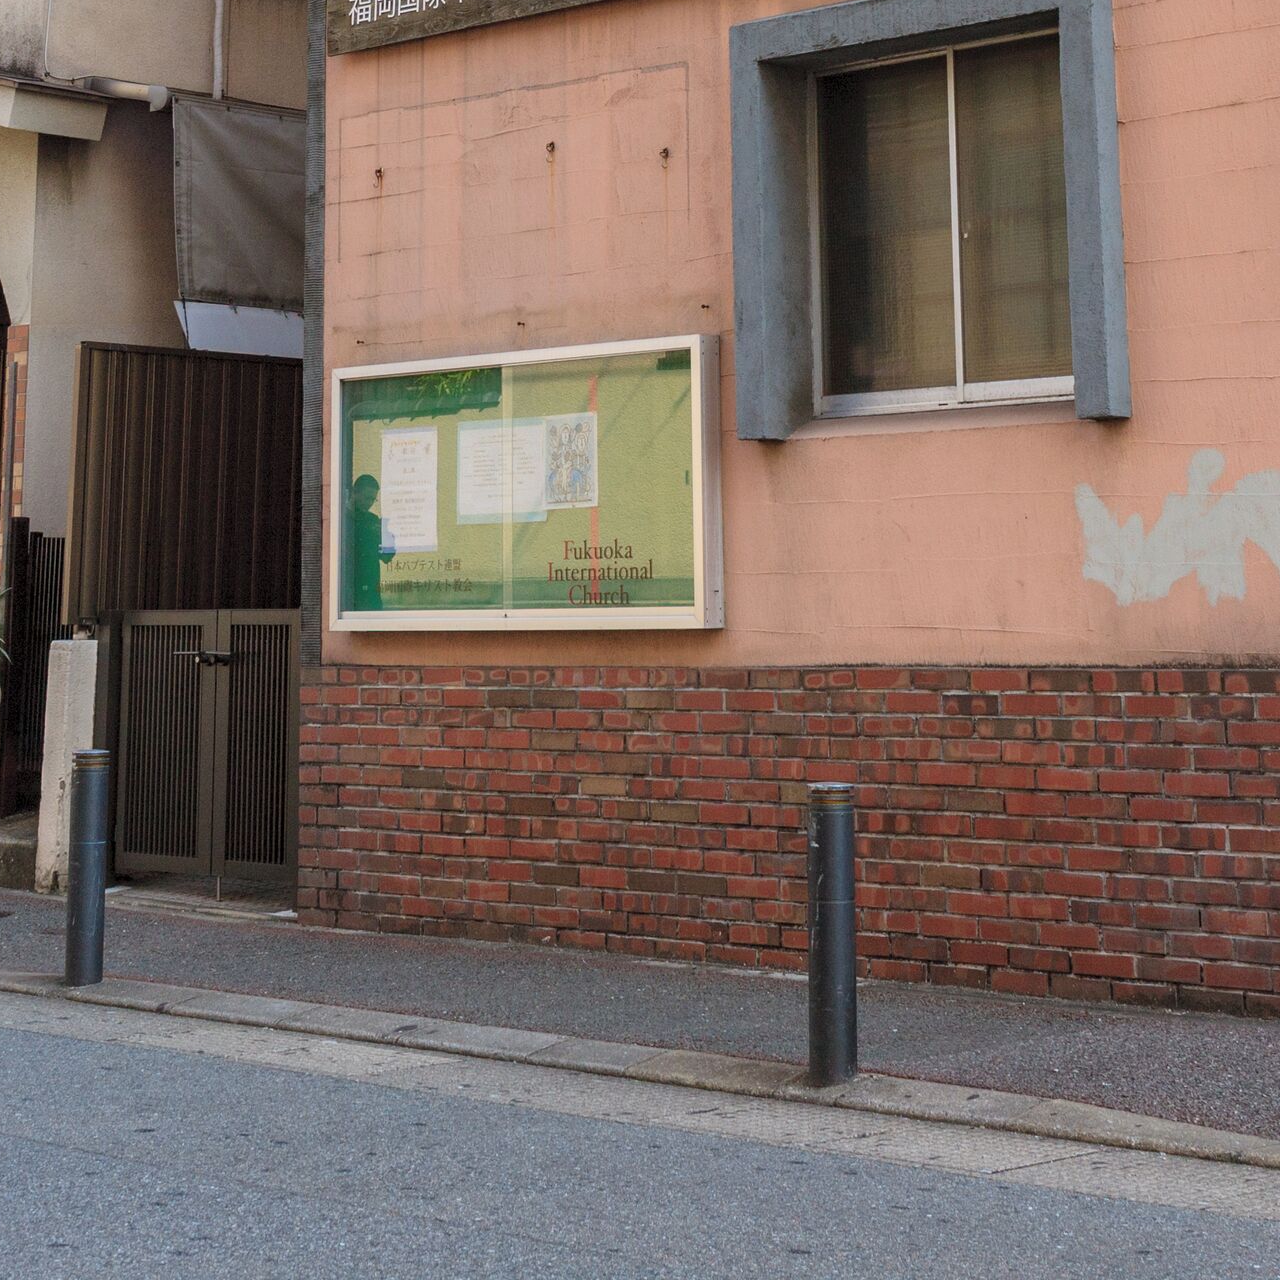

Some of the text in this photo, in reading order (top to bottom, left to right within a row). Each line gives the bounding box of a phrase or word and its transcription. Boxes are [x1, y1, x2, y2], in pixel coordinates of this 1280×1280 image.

[563, 538, 634, 561] Fukuoka
[548, 559, 653, 582] International
[568, 584, 630, 606] Church
